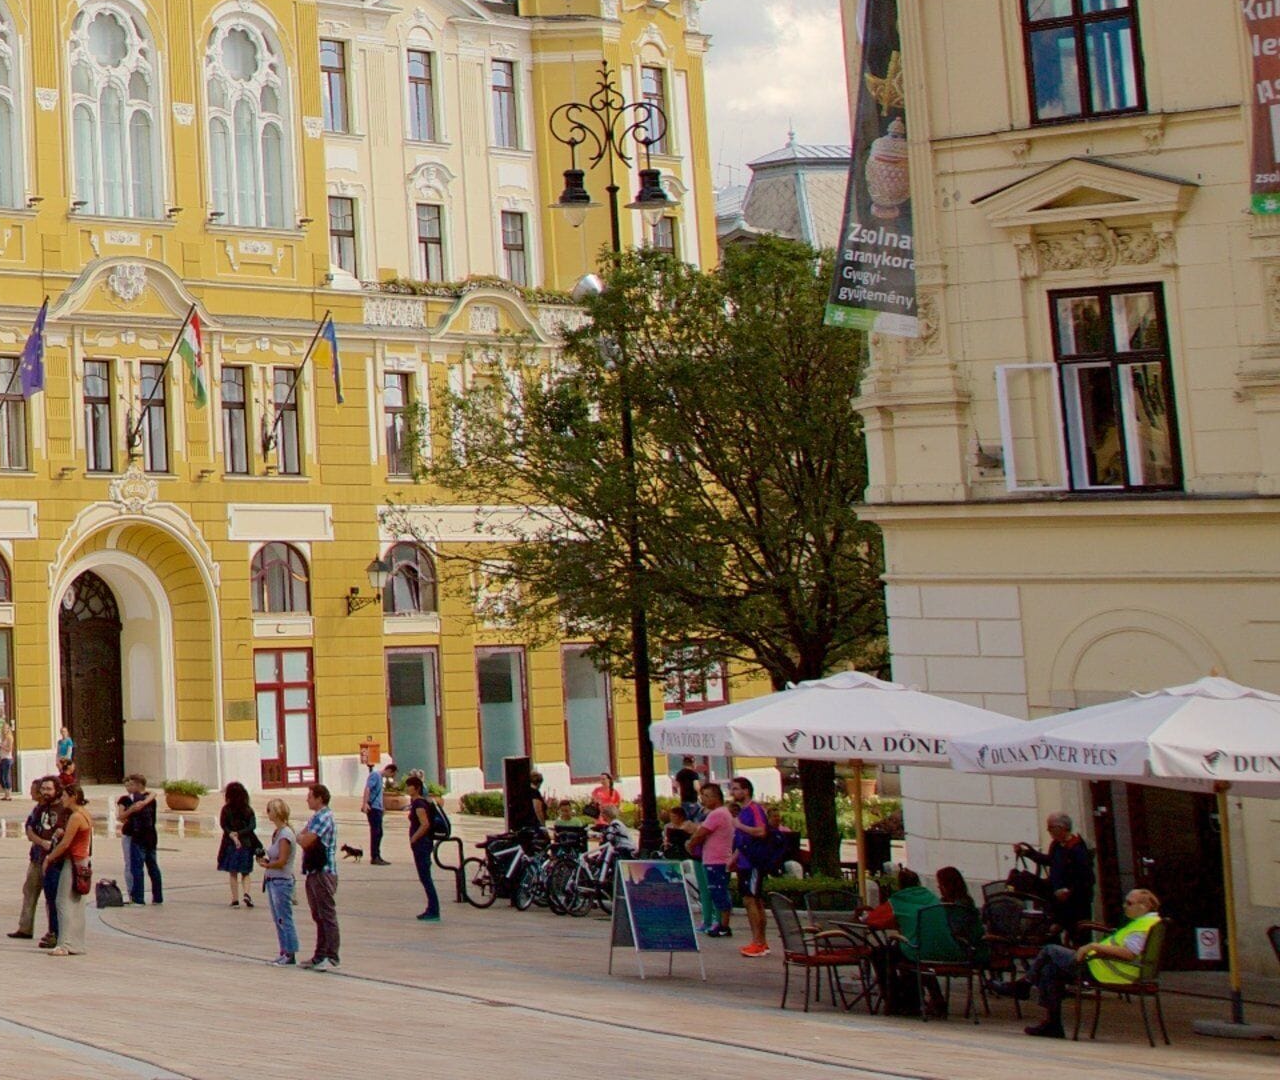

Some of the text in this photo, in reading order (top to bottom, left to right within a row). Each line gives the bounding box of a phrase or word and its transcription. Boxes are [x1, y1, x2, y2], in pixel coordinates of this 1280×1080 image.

[1253, 34, 1280, 59] le
[812, 733, 948, 755] DUNA DÖNE
[991, 739, 1118, 766] DUNA DÖNER PÉCS
